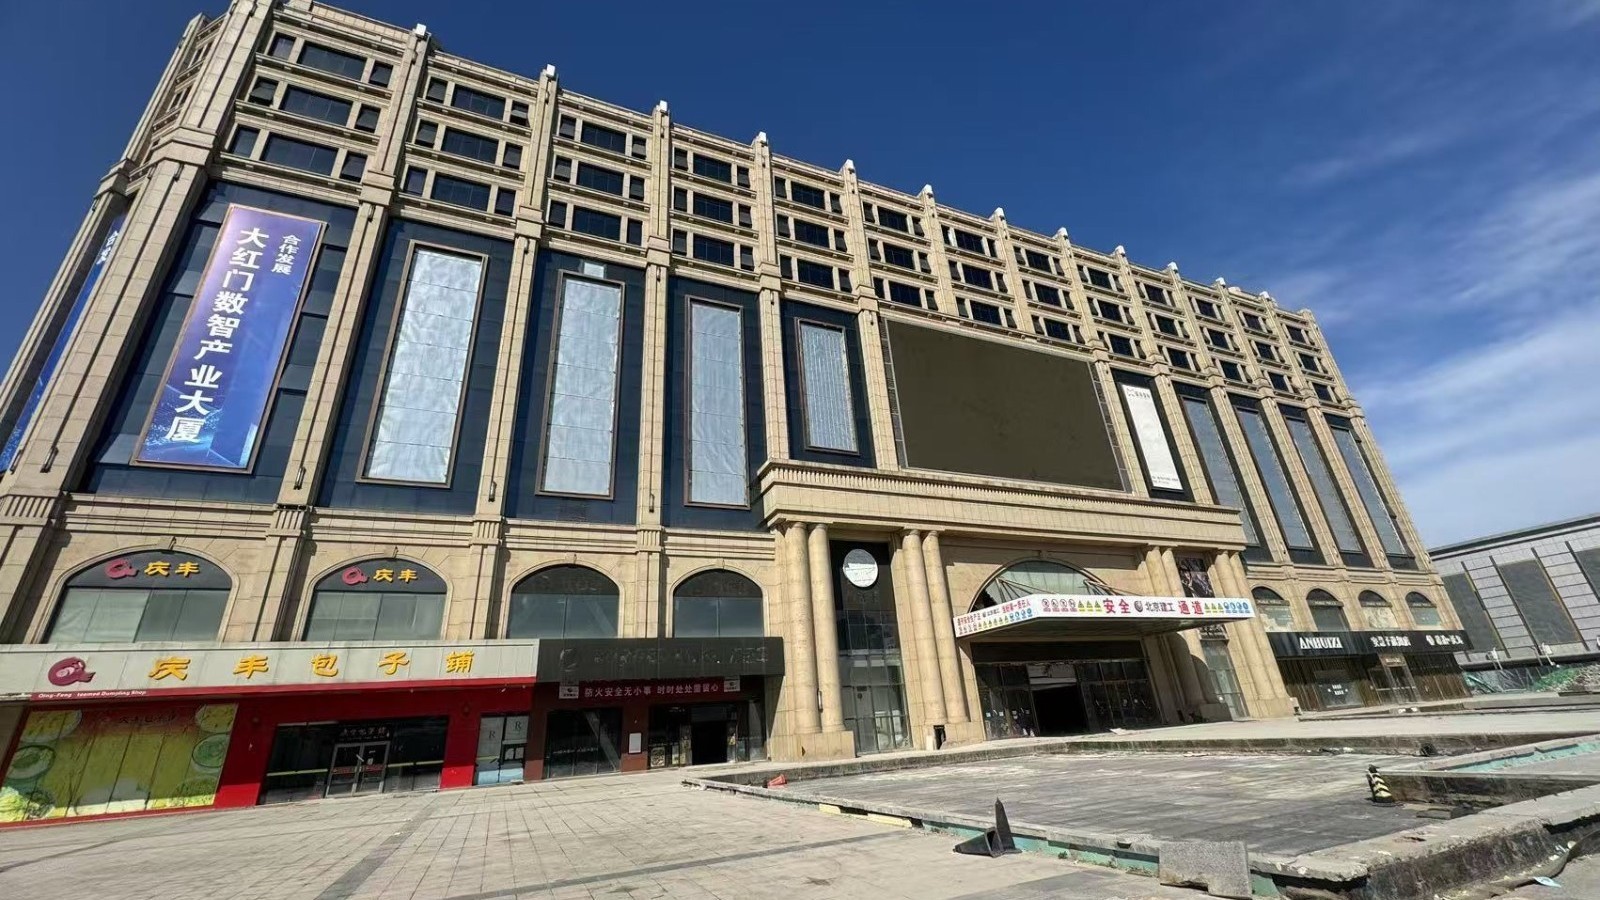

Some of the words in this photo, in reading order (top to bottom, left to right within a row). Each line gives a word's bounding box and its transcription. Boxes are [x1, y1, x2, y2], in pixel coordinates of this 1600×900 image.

[270, 234, 301, 276] 合作发展
[164, 227, 270, 444] 大红门数智产业大厦
[144, 560, 202, 578] 庆丰
[372, 567, 419, 583] 庆丰
[1103, 598, 1131, 615] 安全
[1145, 601, 1176, 613] 北京建工
[1178, 600, 1204, 615] 通道
[148, 649, 475, 682] 庆丰包子铺
[584, 686, 652, 698] 防火安全无小事
